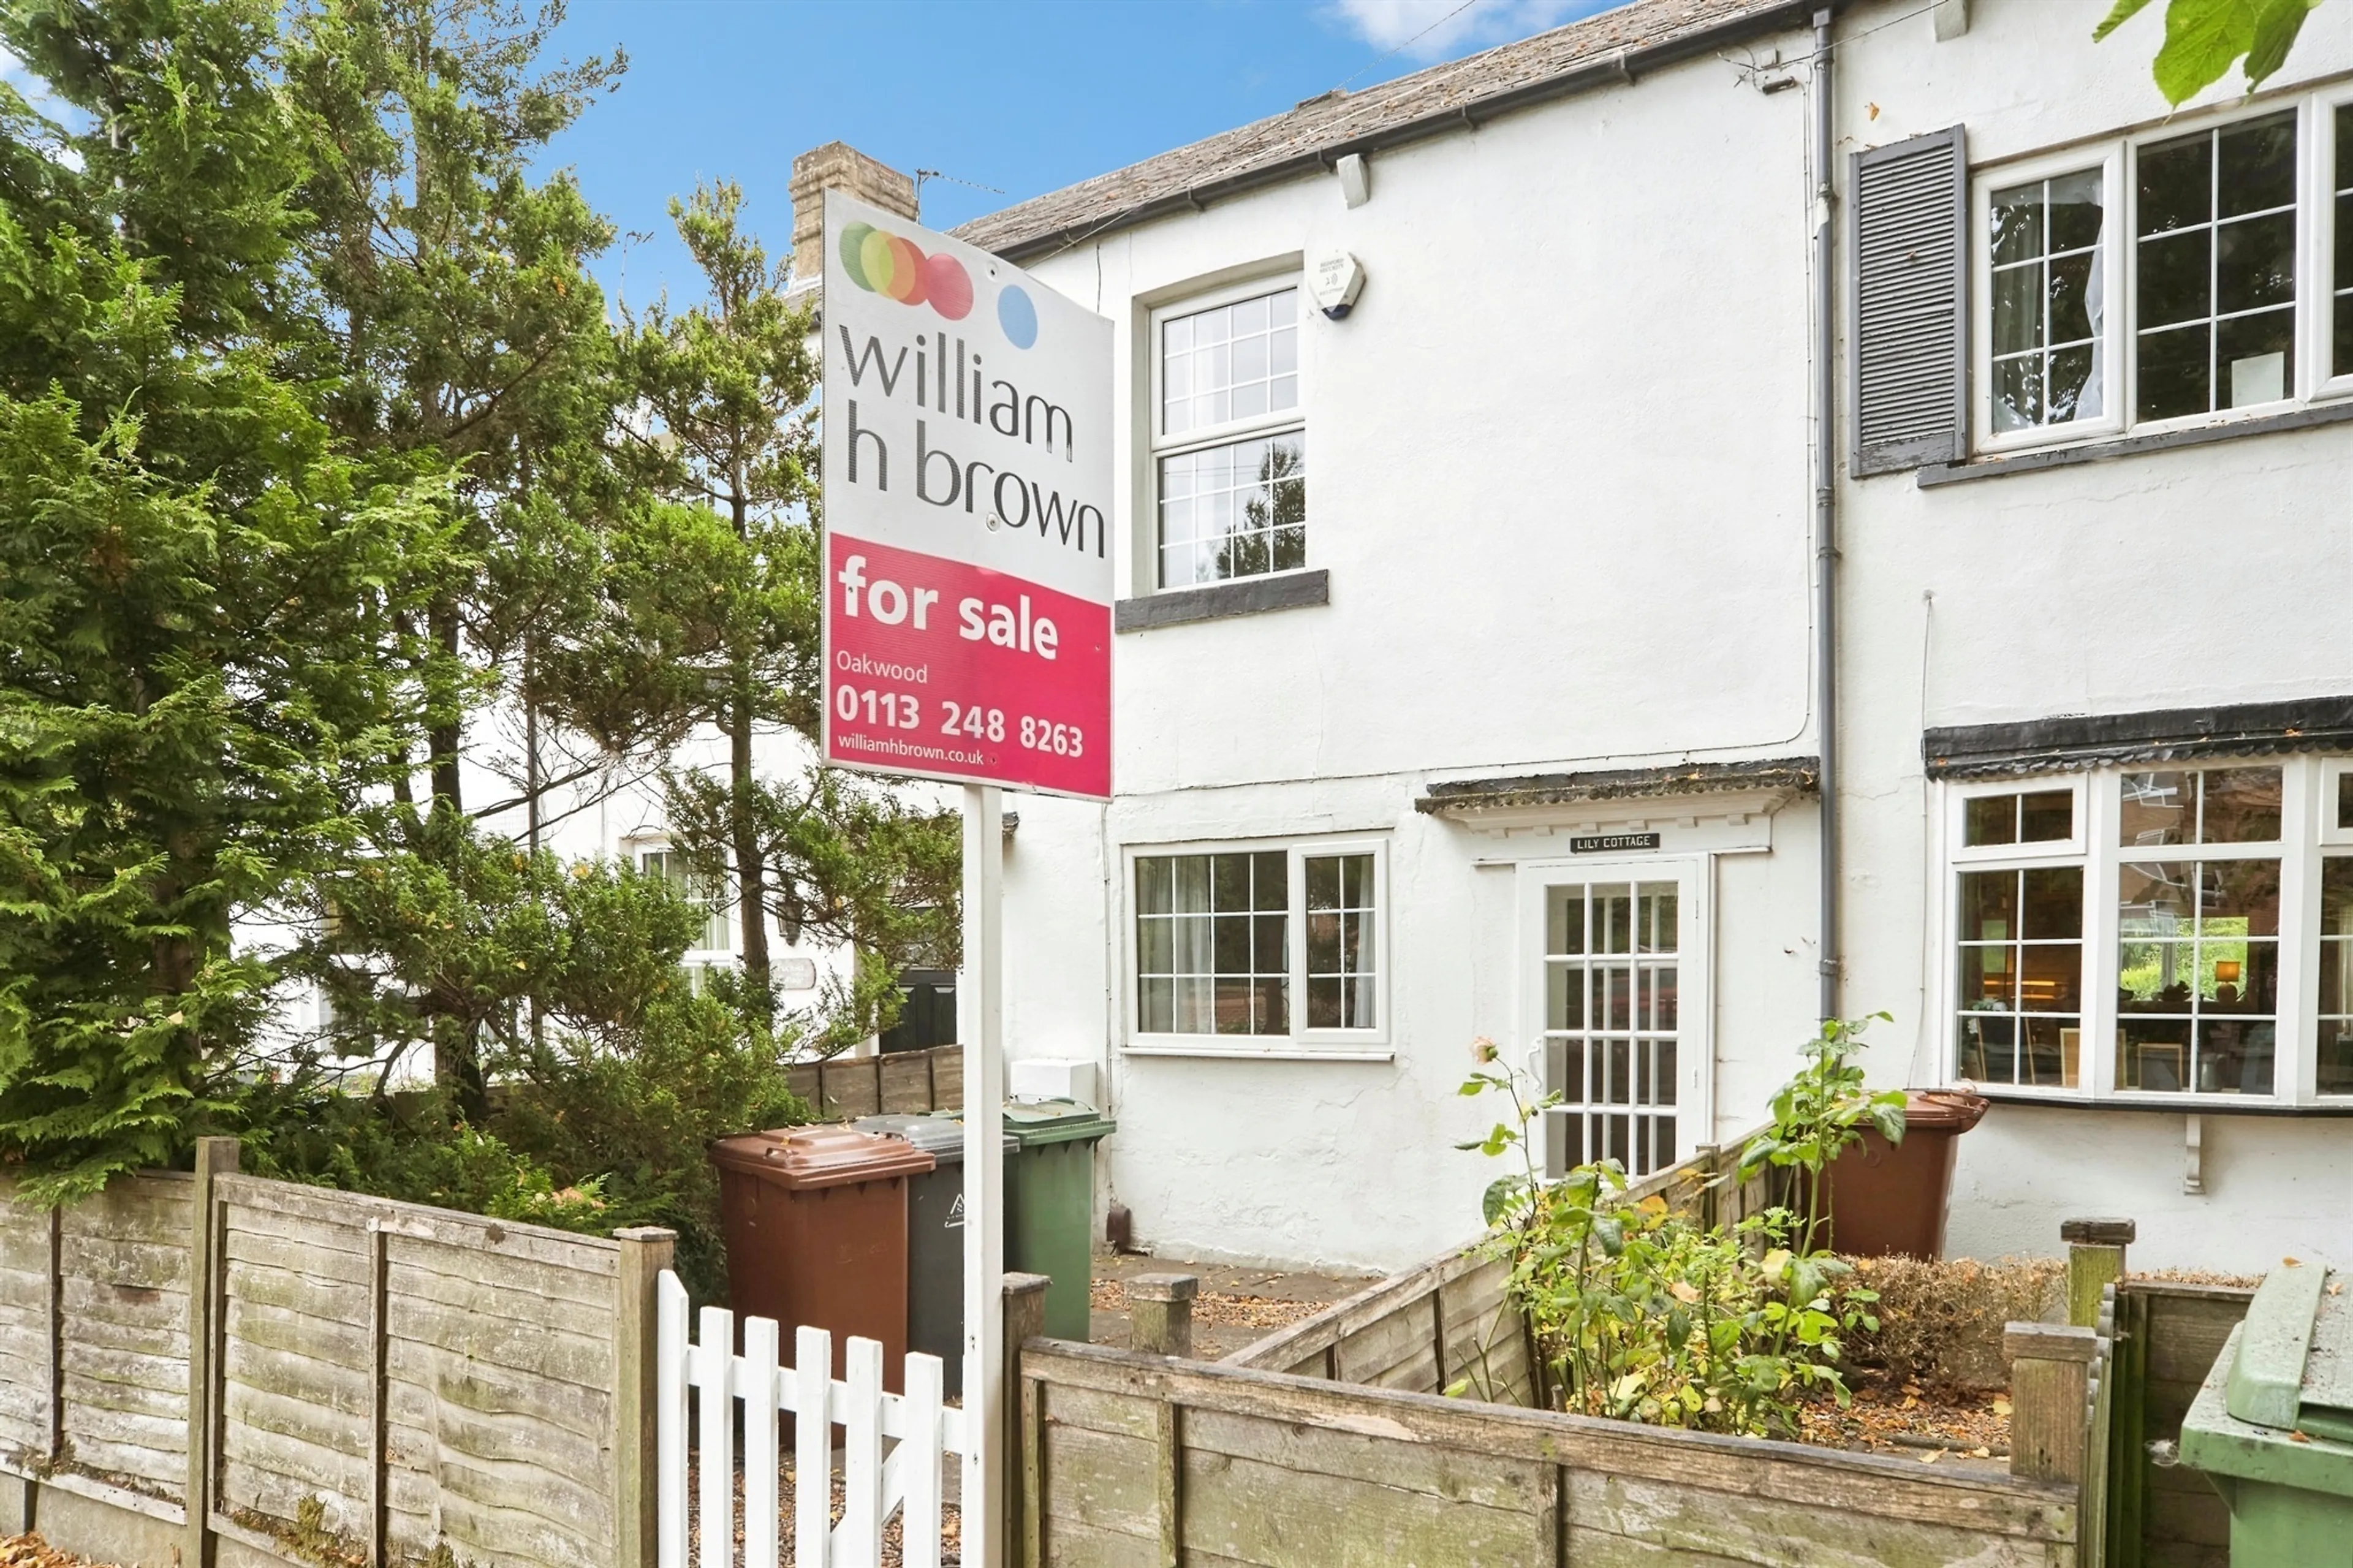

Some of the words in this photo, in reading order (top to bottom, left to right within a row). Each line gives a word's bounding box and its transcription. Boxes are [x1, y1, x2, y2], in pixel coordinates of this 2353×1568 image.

[839, 324, 1073, 463] william
[848, 399, 887, 491] h
[916, 419, 1104, 558] brown
[838, 555, 939, 630] for
[958, 594, 1058, 659] sale
[836, 650, 928, 684] Oakwood
[836, 684, 919, 729] 0113
[941, 701, 1005, 743] 248
[1020, 715, 1083, 757] 8263
[838, 733, 984, 765] williamhbrown.co.uk
[1577, 839, 1599, 849] LILY
[1603, 835, 1651, 848] COTTAGE
